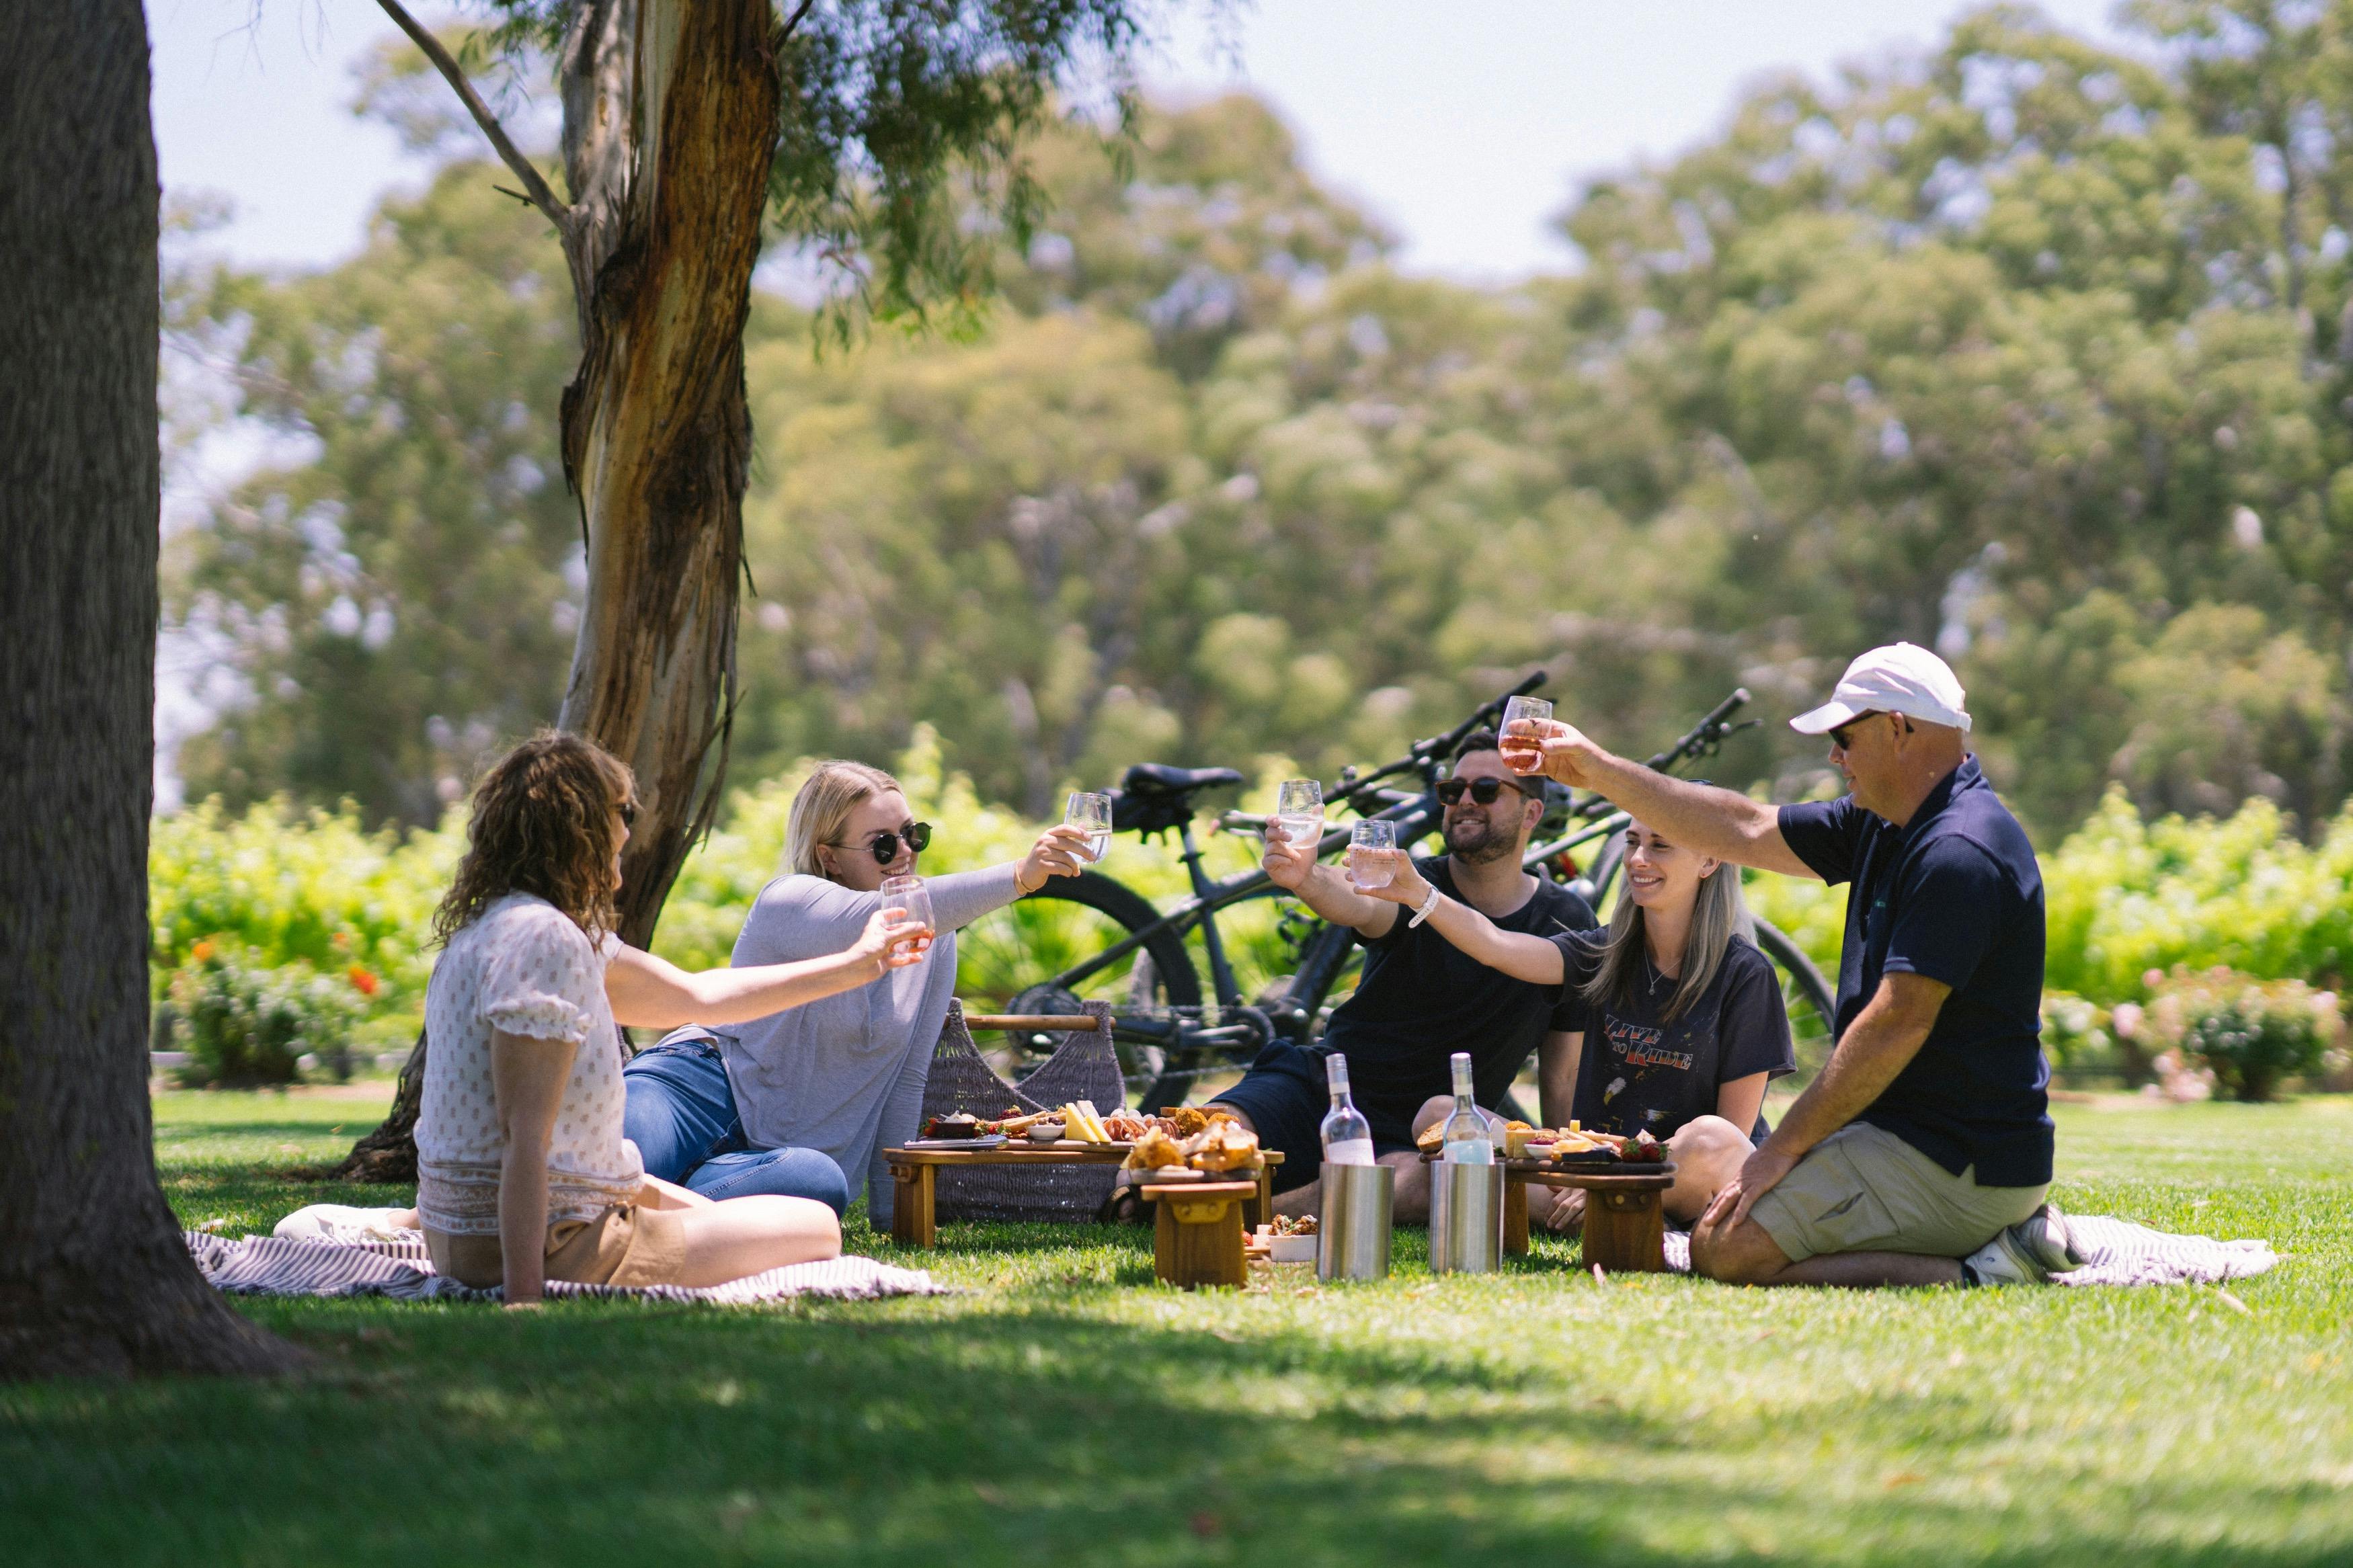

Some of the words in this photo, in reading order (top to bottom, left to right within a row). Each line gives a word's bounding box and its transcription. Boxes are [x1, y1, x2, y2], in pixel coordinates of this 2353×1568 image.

[1603, 1014, 1663, 1044] LIVE
[1612, 1042, 1627, 1054] TO
[1625, 1040, 1693, 1070] RIDE
